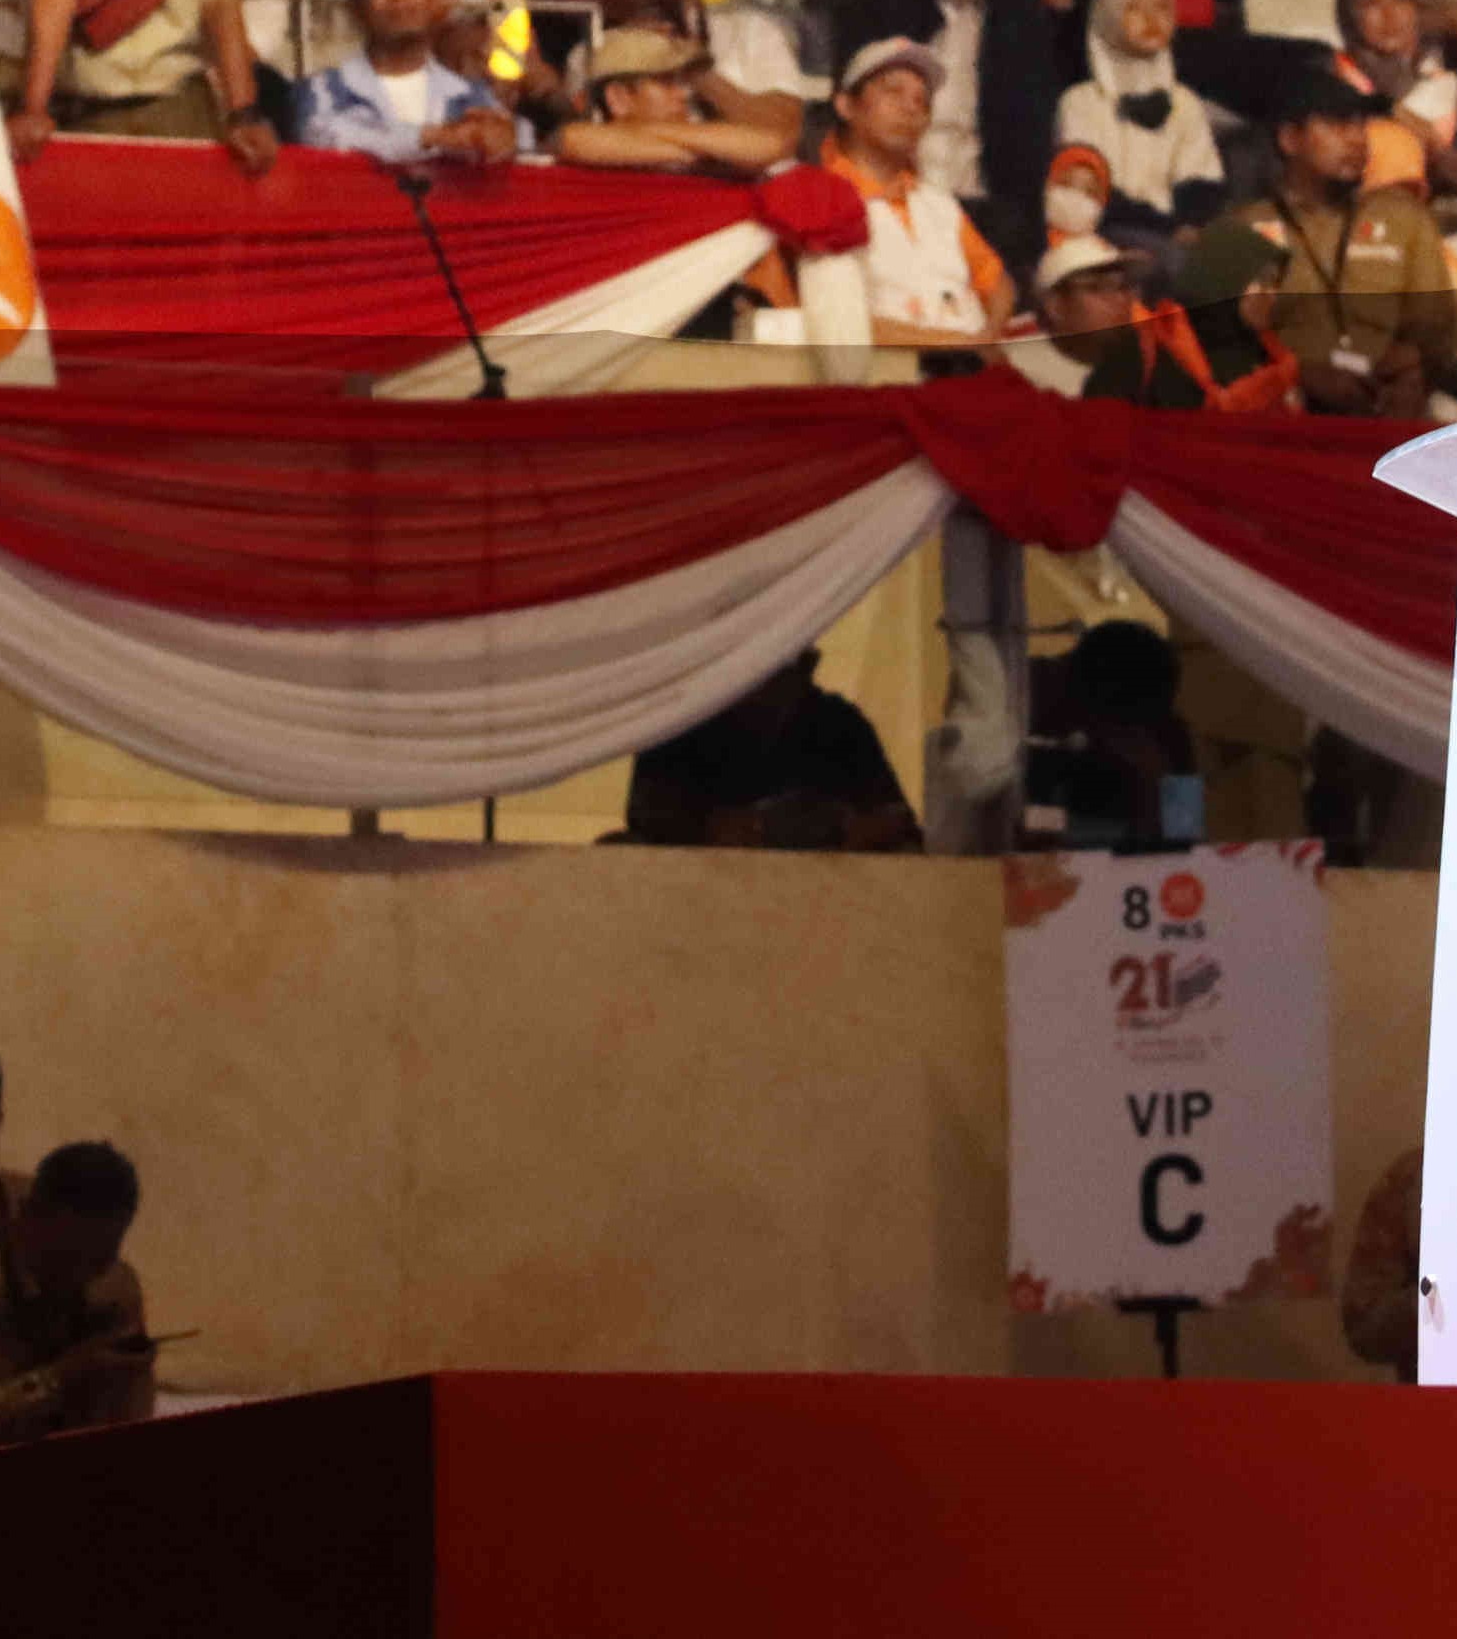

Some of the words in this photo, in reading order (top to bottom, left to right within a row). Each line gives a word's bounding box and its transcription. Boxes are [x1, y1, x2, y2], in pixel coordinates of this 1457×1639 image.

[1123, 885, 1151, 930] 8
[1126, 1089, 1214, 1138] VIP
[1139, 1153, 1204, 1246] C
